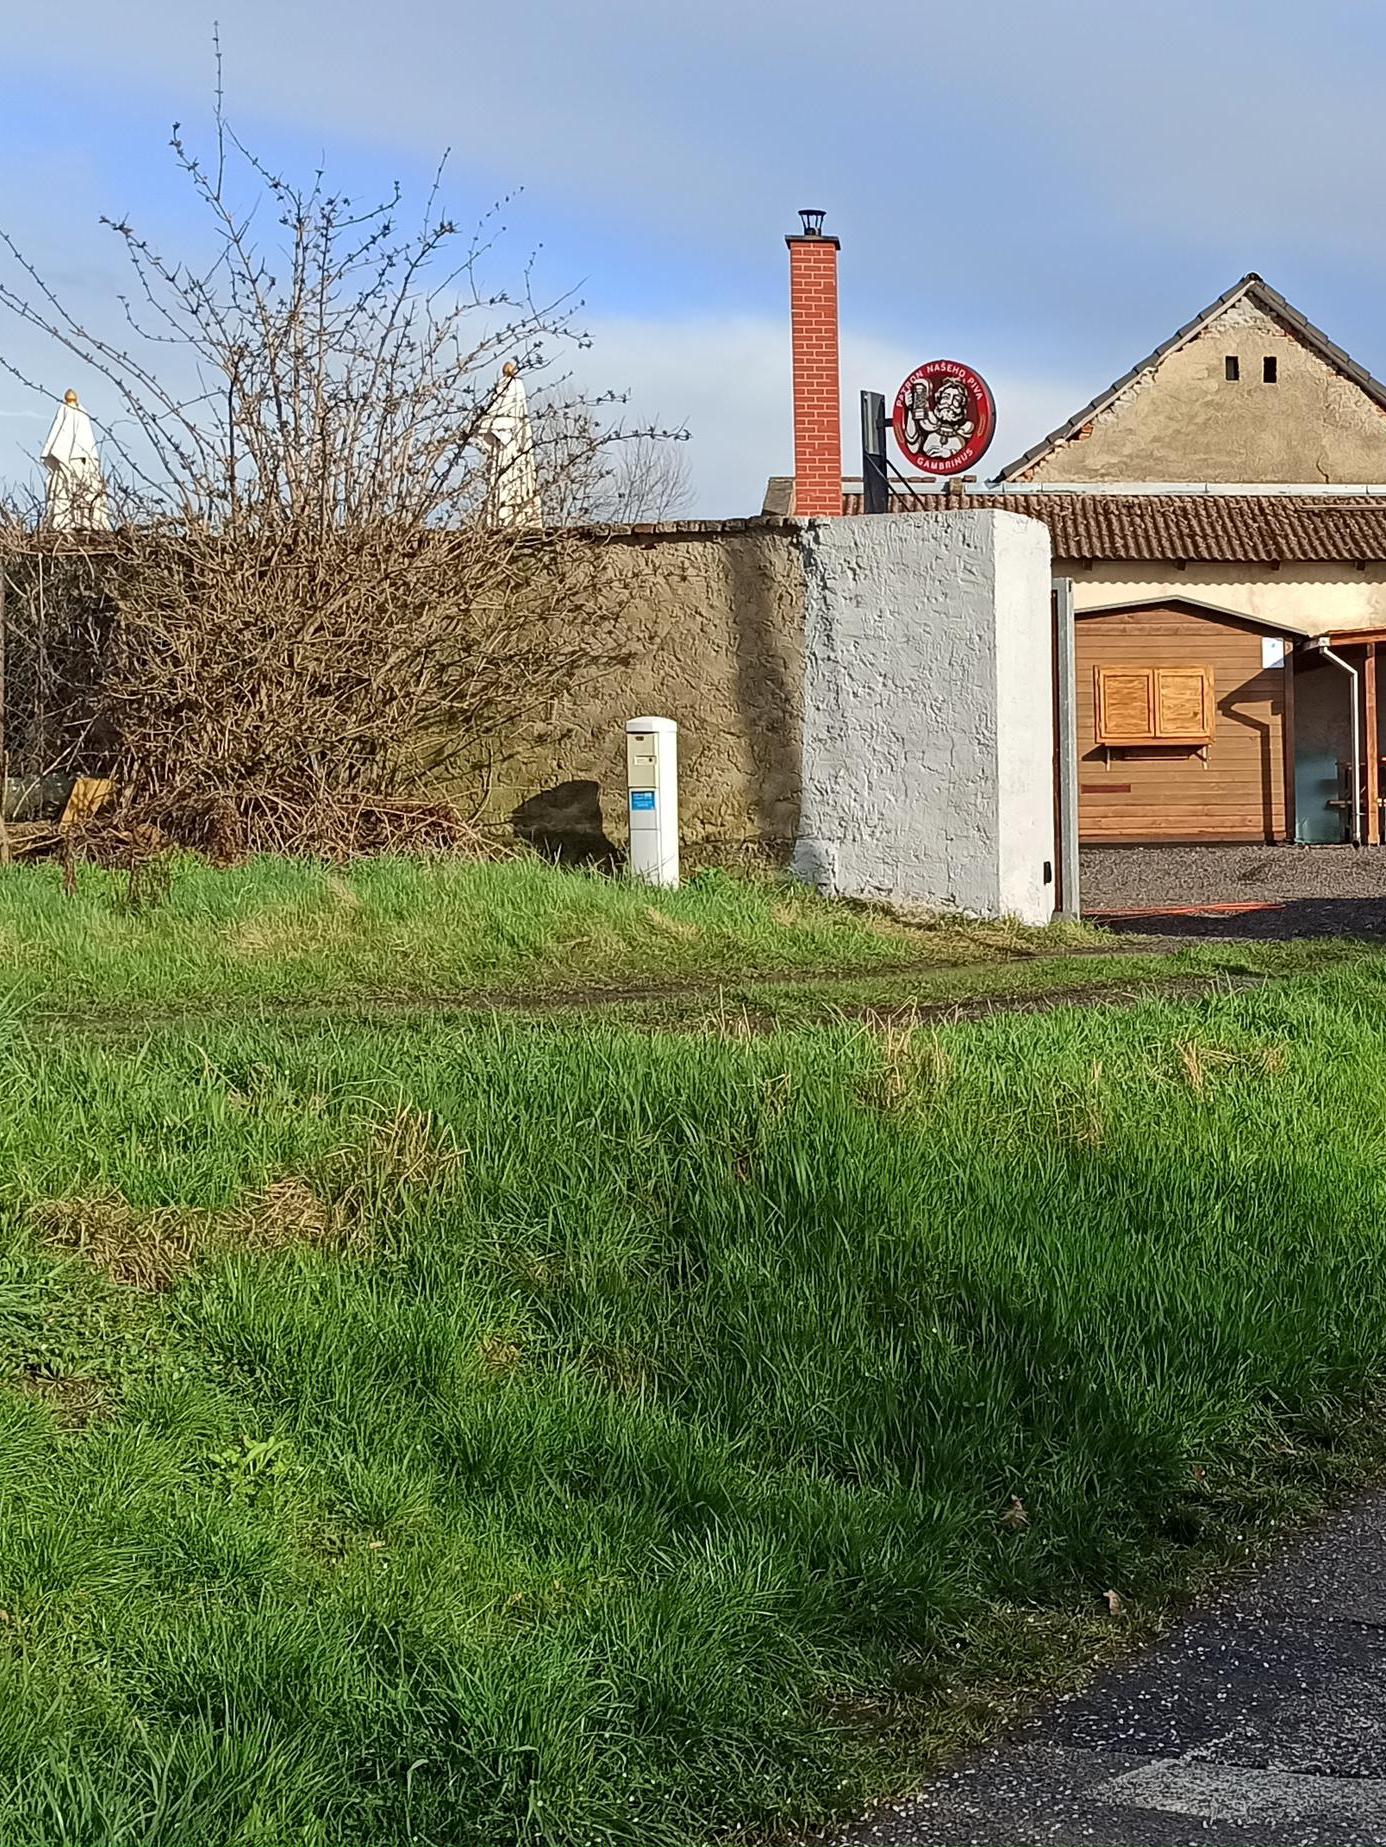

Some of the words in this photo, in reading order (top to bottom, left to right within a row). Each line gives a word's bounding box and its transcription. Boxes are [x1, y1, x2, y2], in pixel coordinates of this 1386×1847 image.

[896, 370, 924, 408] PATRON
[926, 362, 966, 378] NAŠEHO
[967, 377, 984, 401] PIVA
[916, 448, 974, 470] GAMBRINUS
